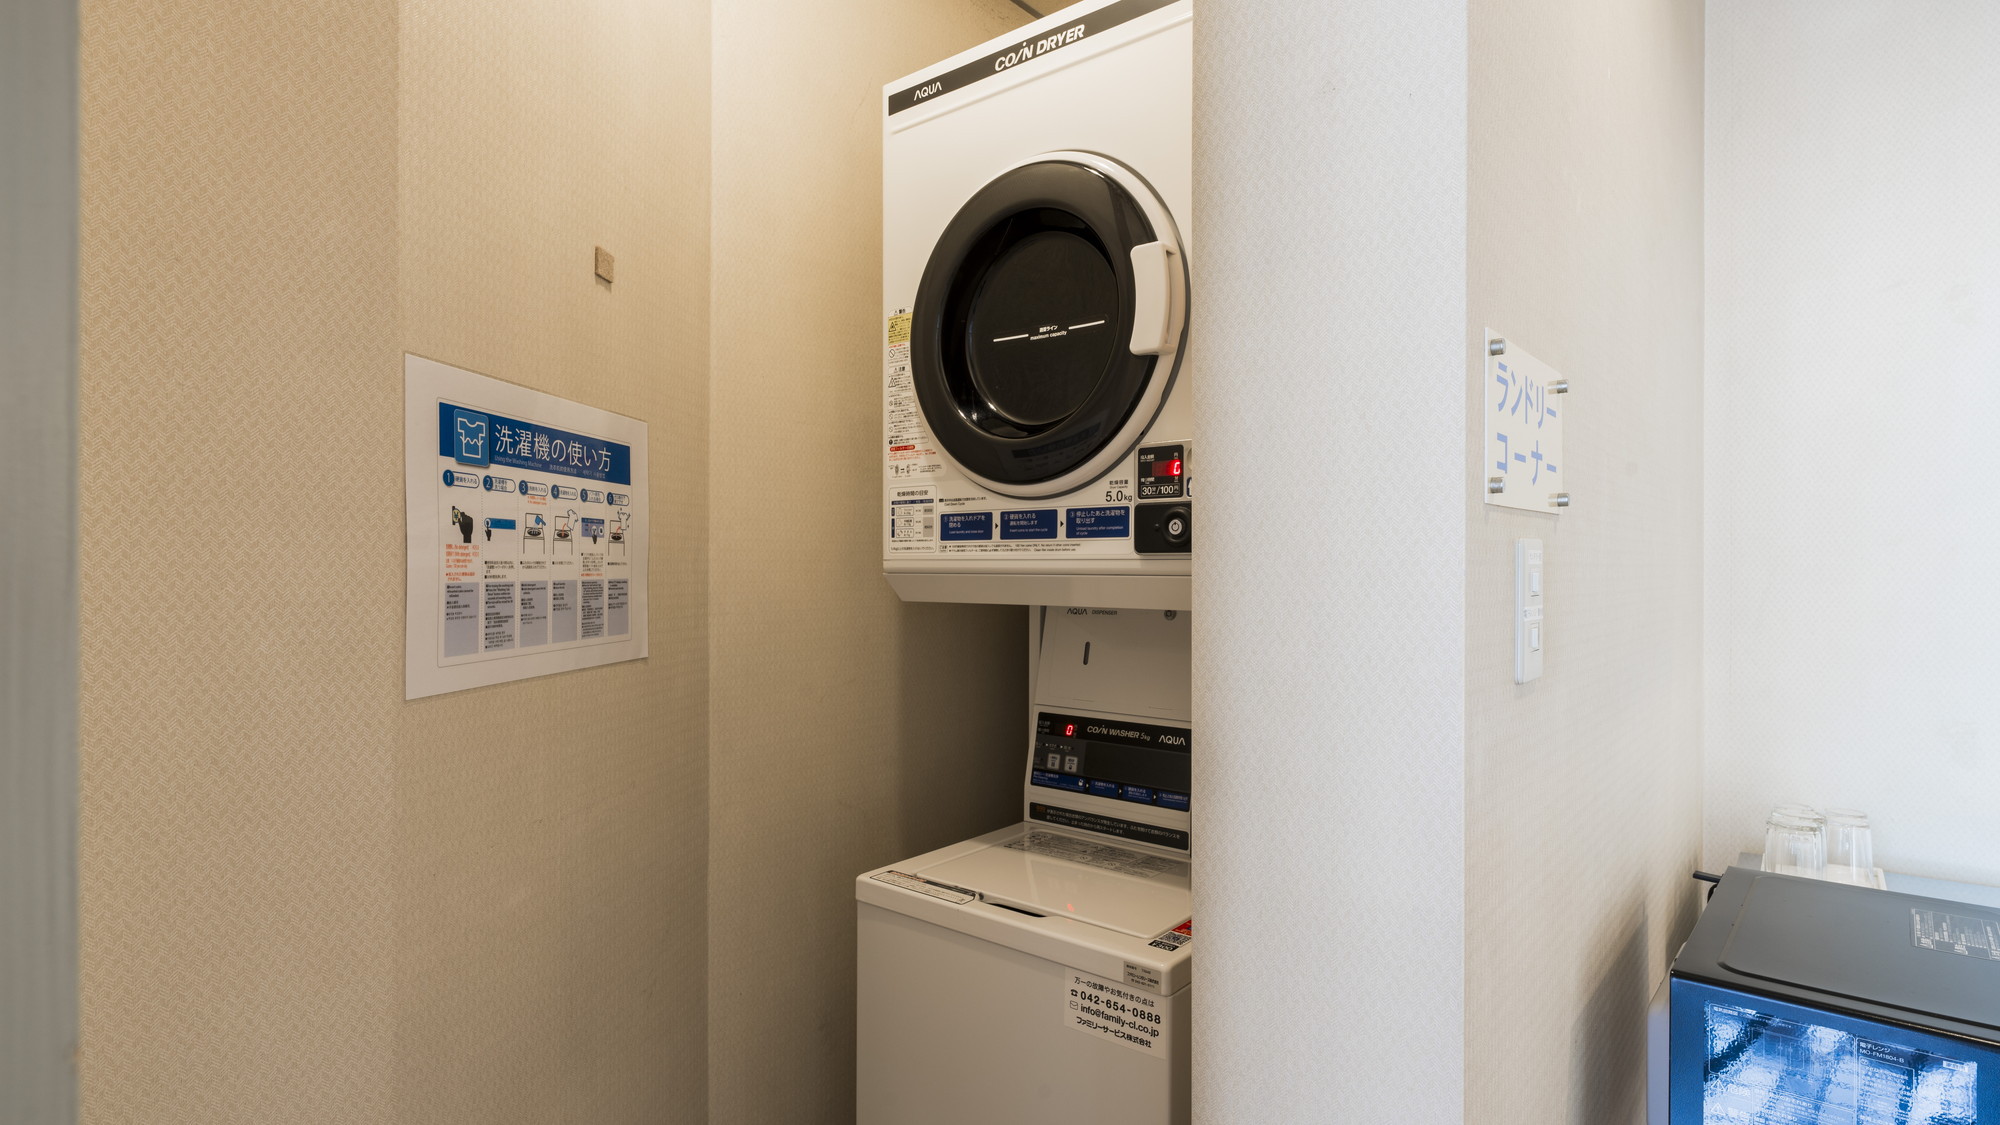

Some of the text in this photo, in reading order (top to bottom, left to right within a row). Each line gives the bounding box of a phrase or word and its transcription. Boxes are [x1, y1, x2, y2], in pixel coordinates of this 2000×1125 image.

[995, 24, 1085, 72] COIN DRYER
[913, 82, 942, 100] AQUA
[1030, 330, 1067, 341] maximum capacity
[1496, 361, 1557, 429] ランドリー
[495, 424, 612, 472] 洗濯機の使い方
[1496, 432, 1557, 486] コーナー
[1066, 725, 1073, 735] 0
[1087, 725, 1109, 735] COIN
[1109, 728, 1140, 739] WASHER
[1159, 735, 1186, 746] AQUA
[1074, 977, 1155, 1007] 万一の故障やお気付きの点は
[1080, 991, 1161, 1024] 042-654-0888
[1076, 1016, 1152, 1048] ファミリーサービス株式会社
[1081, 1004, 1159, 1037] info@family-cl.co.jp
[1860, 1041, 1891, 1053] 電子レンジ
